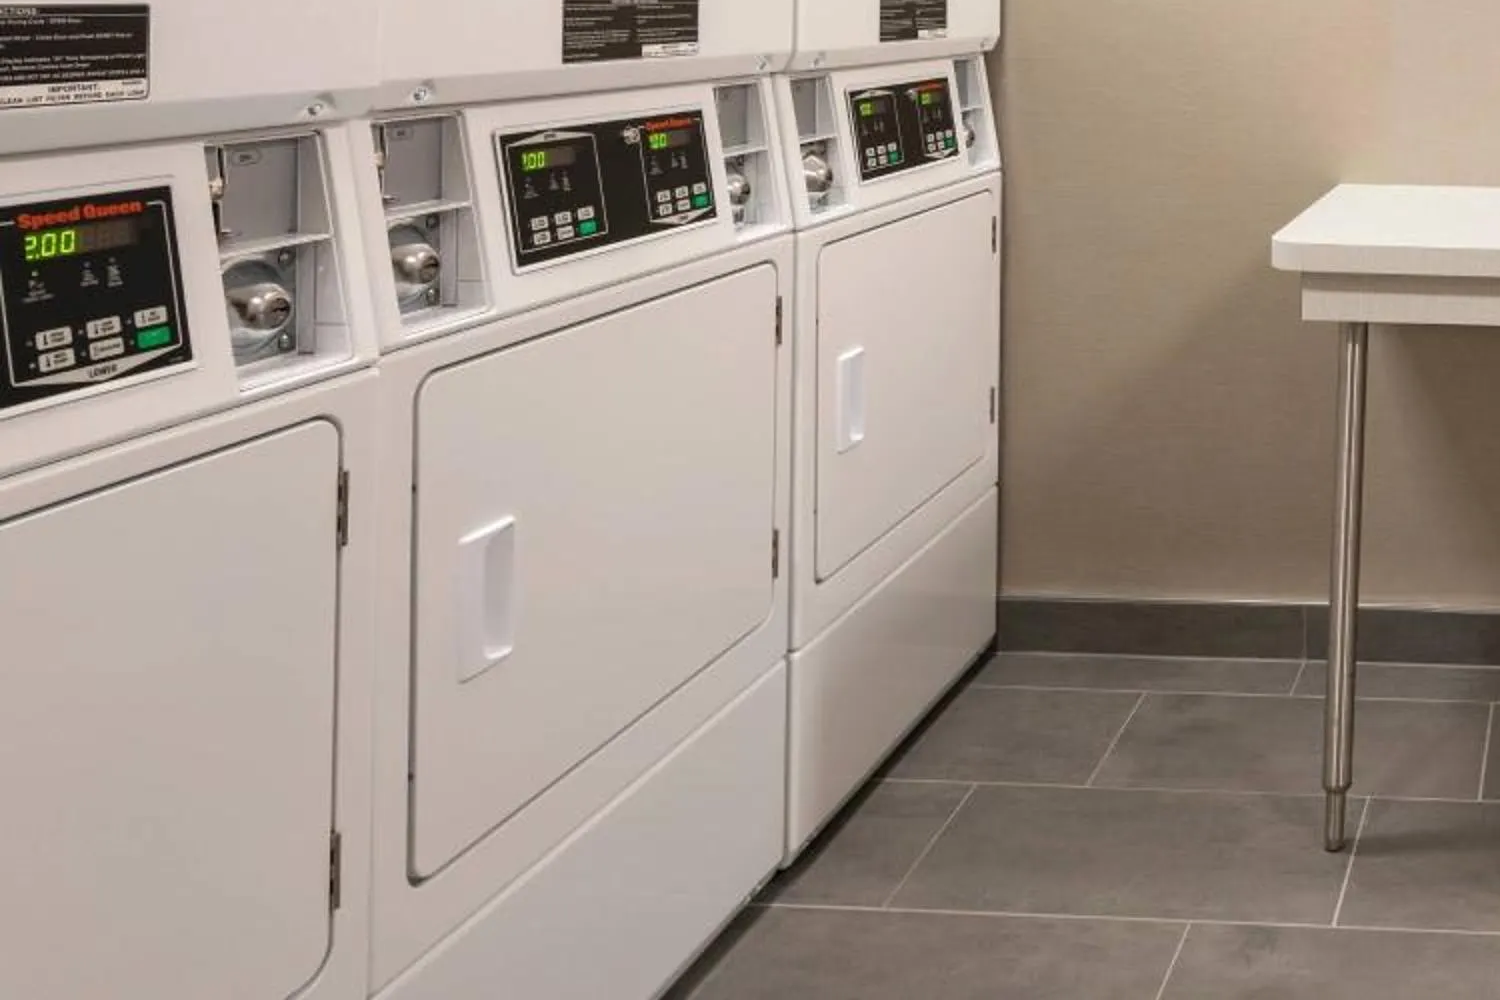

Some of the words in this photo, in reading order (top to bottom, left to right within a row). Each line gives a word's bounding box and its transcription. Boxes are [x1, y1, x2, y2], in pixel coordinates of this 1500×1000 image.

[17, 207, 81, 230] Speed
[83, 200, 143, 218] Queen
[24, 229, 76, 260] 2.00
